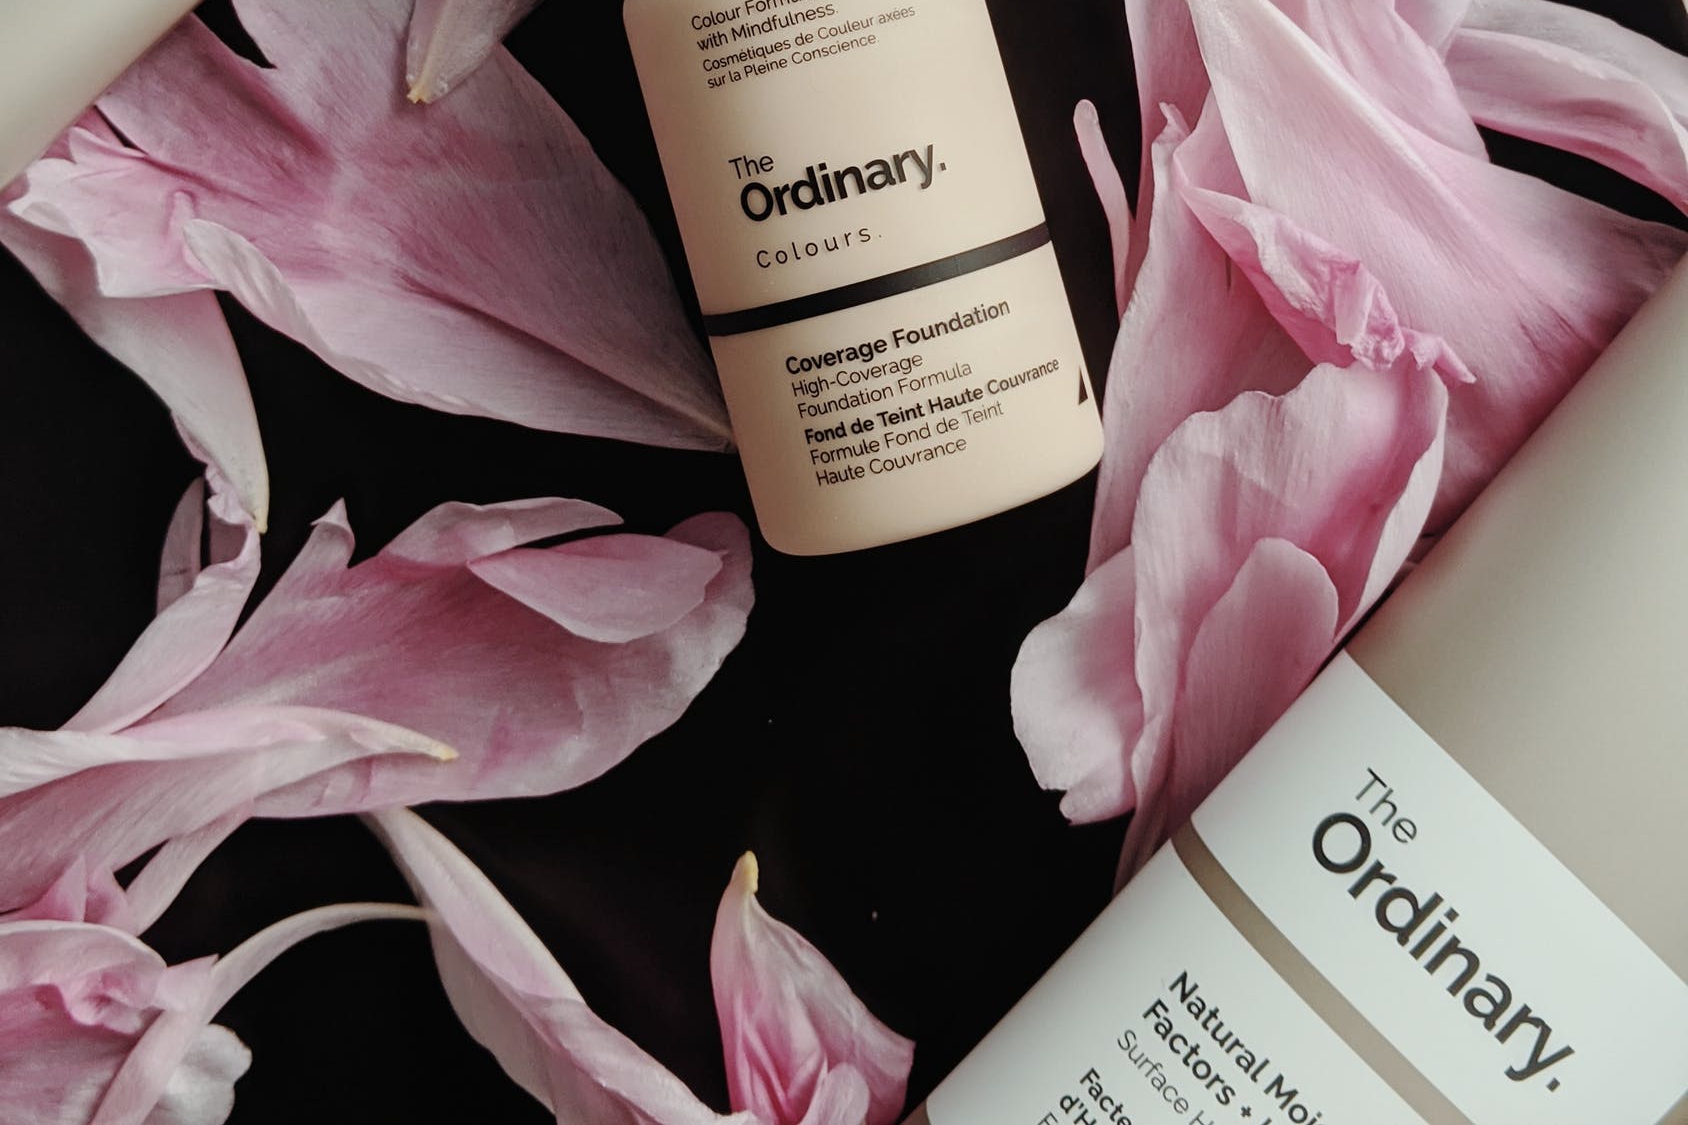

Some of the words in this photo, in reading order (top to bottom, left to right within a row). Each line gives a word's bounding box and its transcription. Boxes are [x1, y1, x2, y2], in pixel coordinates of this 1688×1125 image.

[691, 5, 742, 31] Colour
[697, 31, 729, 52] with
[731, 2, 839, 42] Mindfulness.
[703, 38, 791, 72] Cosmétiques
[794, 32, 814, 47] de
[817, 16, 874, 40] Couleur
[707, 75, 727, 89] sur
[728, 69, 742, 83] la
[744, 58, 788, 77] Pleine
[728, 155, 775, 180] The
[740, 144, 948, 222] Ordinary.
[756, 228, 882, 269] Colours.
[785, 336, 888, 375] Coverage
[892, 299, 1011, 349] Foundation
[791, 353, 923, 398] High-Coverage
[797, 380, 894, 419] Foundation
[897, 361, 973, 396] Formula
[804, 425, 847, 445] Fond
[851, 416, 874, 433] de
[876, 402, 924, 427] Teint
[928, 387, 984, 415] Haute
[987, 357, 1060, 395] Couvrance
[809, 438, 880, 466] Formule
[884, 424, 931, 449] Fond
[936, 416, 959, 433] de
[962, 401, 1004, 426] Teint
[815, 462, 866, 486] Haute
[869, 436, 967, 475] Couvrance
[1351, 768, 1418, 845] The
[1312, 812, 1576, 1094] Ordinary.
[1117, 1028, 1189, 1114] Surface
[1142, 998, 1236, 1106] Factors
[1168, 969, 1270, 1083] Natural
[1263, 1073, 1325, 1125] Moi
